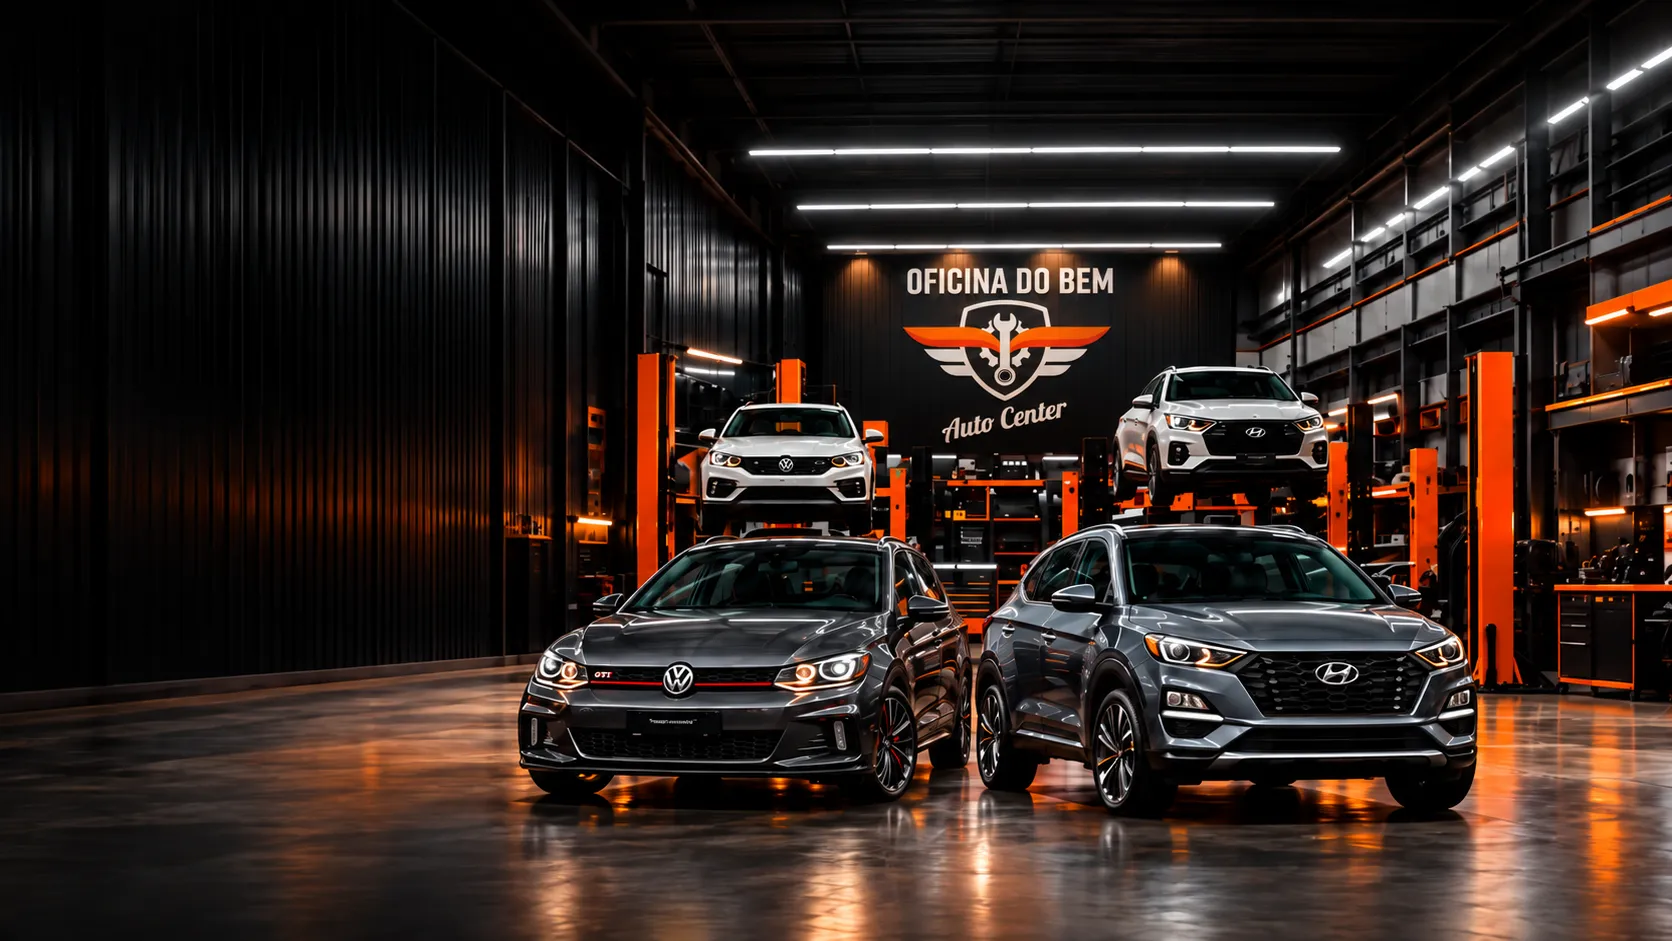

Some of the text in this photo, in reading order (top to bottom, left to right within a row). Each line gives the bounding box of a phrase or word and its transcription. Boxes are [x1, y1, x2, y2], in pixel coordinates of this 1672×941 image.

[907, 267, 1114, 294] OFICINA DO BEM
[942, 402, 1067, 443] Auto Center
